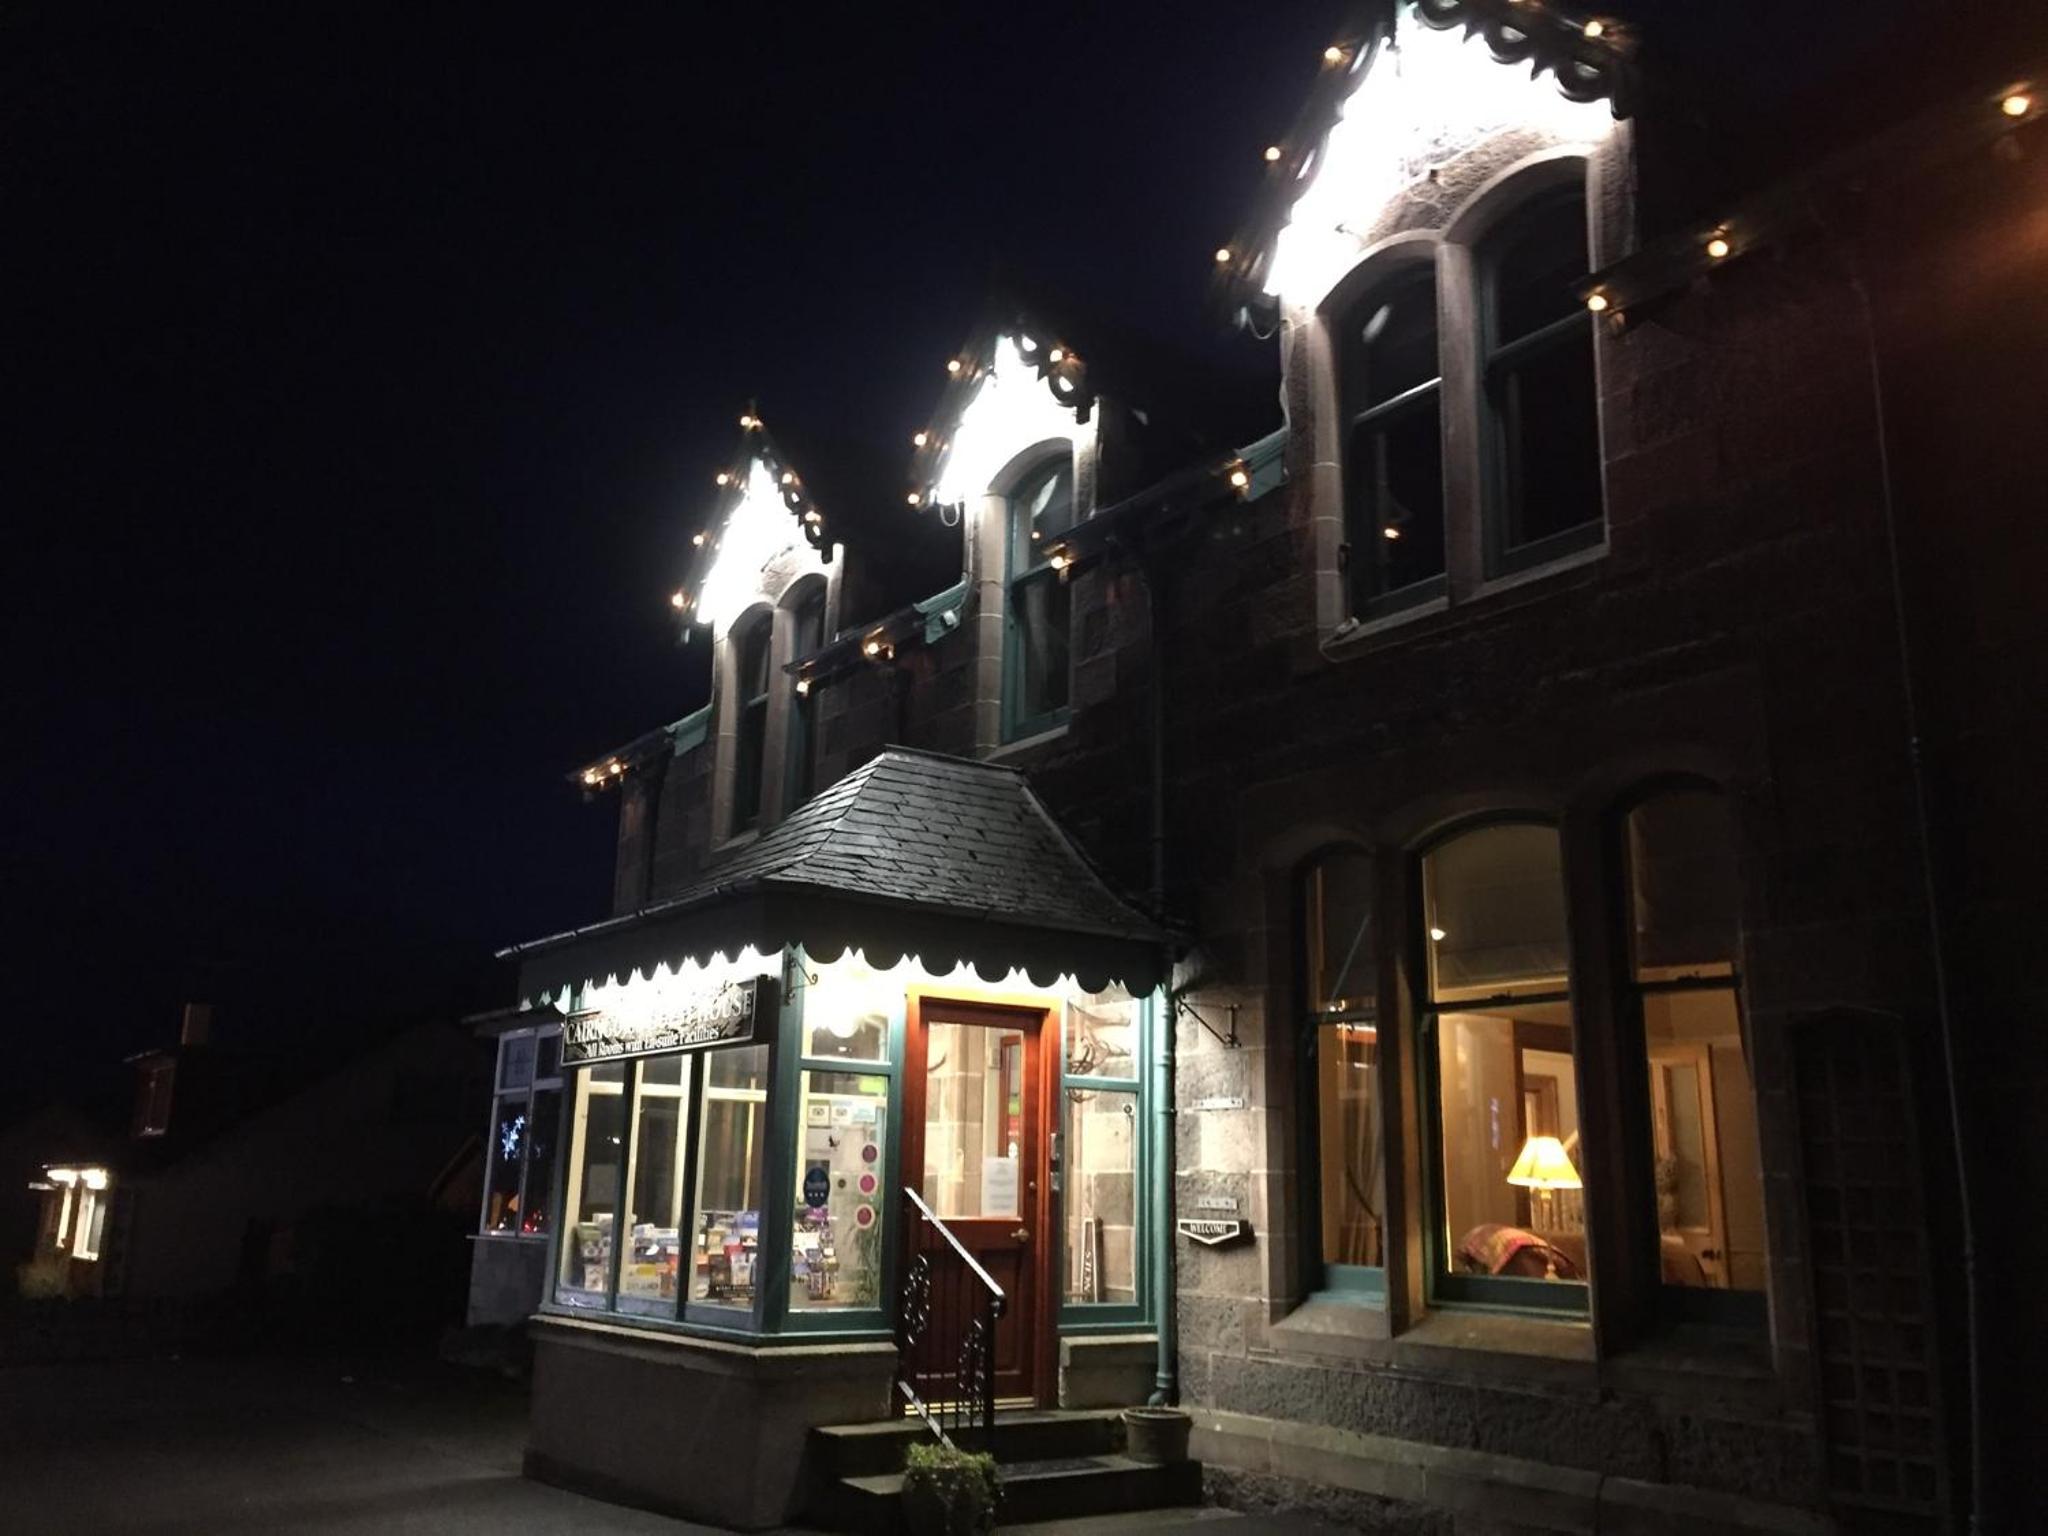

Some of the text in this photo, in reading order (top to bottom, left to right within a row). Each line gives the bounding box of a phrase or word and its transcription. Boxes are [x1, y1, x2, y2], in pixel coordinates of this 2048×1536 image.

[599, 1041, 624, 1056] Rooms
[625, 1038, 642, 1052] with
[680, 1026, 719, 1045] Facilities
[1190, 1223, 1227, 1234] WELCOME
